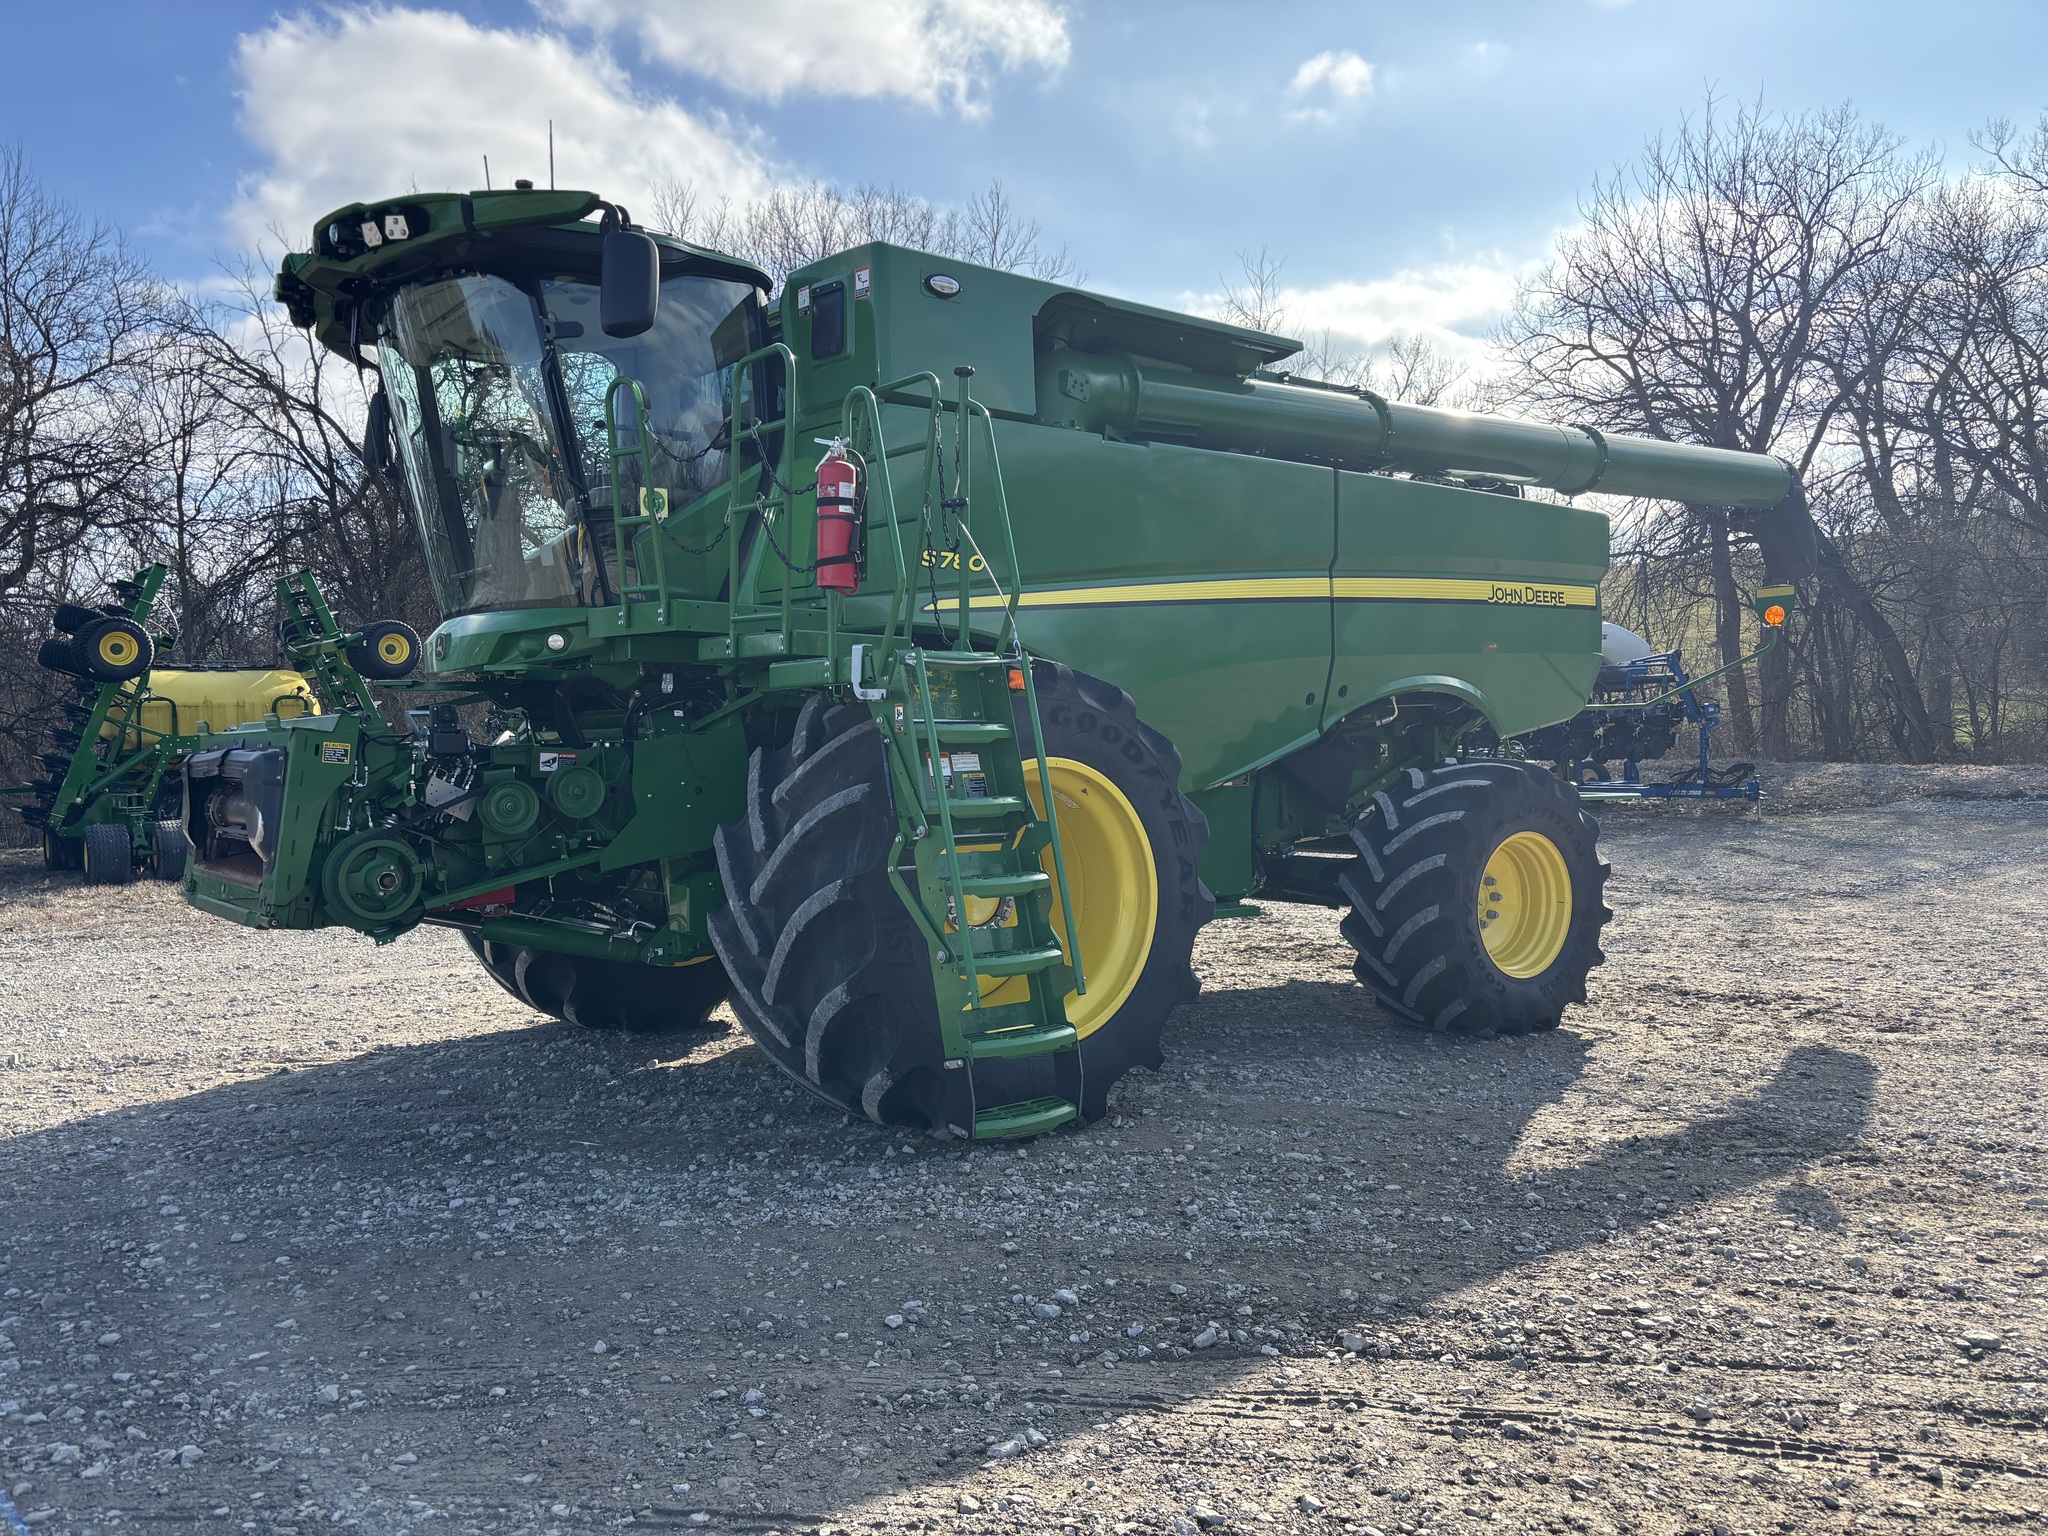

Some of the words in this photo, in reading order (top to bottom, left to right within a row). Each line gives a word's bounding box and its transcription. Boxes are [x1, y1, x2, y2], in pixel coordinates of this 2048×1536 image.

[920, 548, 986, 572] S780
[1487, 584, 1523, 603] JOHN
[1525, 586, 1566, 605] DEERE
[1047, 705, 1194, 924] GOODYEAR
